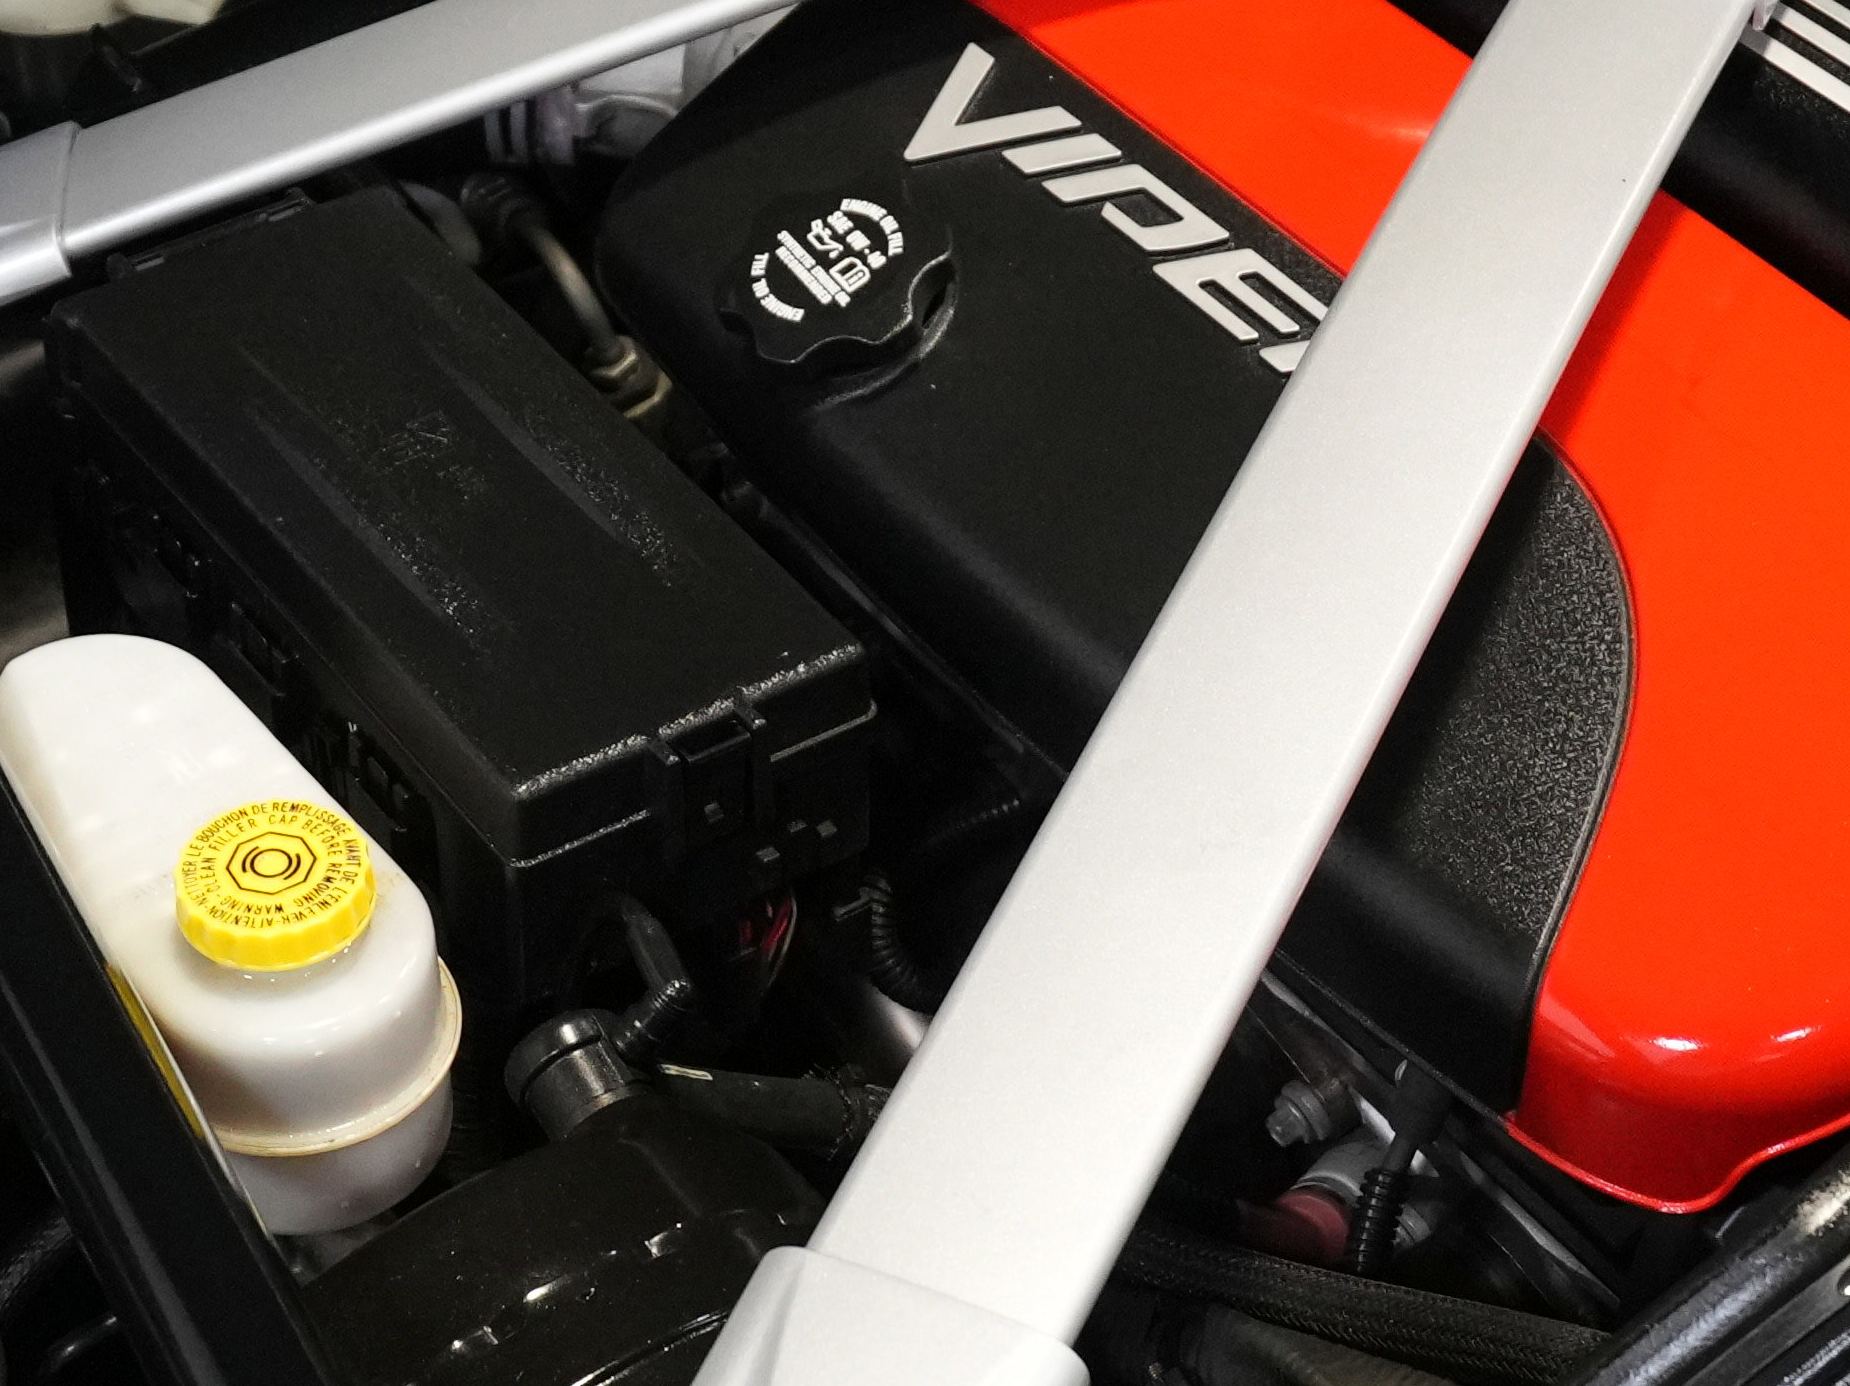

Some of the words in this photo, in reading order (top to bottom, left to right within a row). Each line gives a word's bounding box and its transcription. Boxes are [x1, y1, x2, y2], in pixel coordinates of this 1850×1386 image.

[826, 210, 854, 235] SAE
[840, 198, 888, 222] ENGINE
[903, 41, 1330, 375] VIPE
[879, 215, 899, 235] OIL
[887, 231, 904, 257] FILL
[750, 252, 770, 277] FILL
[775, 245, 833, 305] RECOMMENDED
[776, 229, 817, 269] SYNTHETIC
[810, 265, 842, 296] ENGINE
[834, 290, 851, 308] OIL
[751, 277, 770, 299] OIL
[759, 293, 805, 323] ENGINE
[268, 814, 298, 825] CAP
[185, 843, 205, 857] LE
[195, 808, 249, 843] BOUCHON
[251, 803, 268, 815] DE
[272, 801, 352, 836] REMPLISSAGE
[339, 870, 358, 885] DE
[208, 818, 258, 852] FILLER
[301, 818, 343, 857] BEFORE
[292, 862, 343, 907] REMOVING
